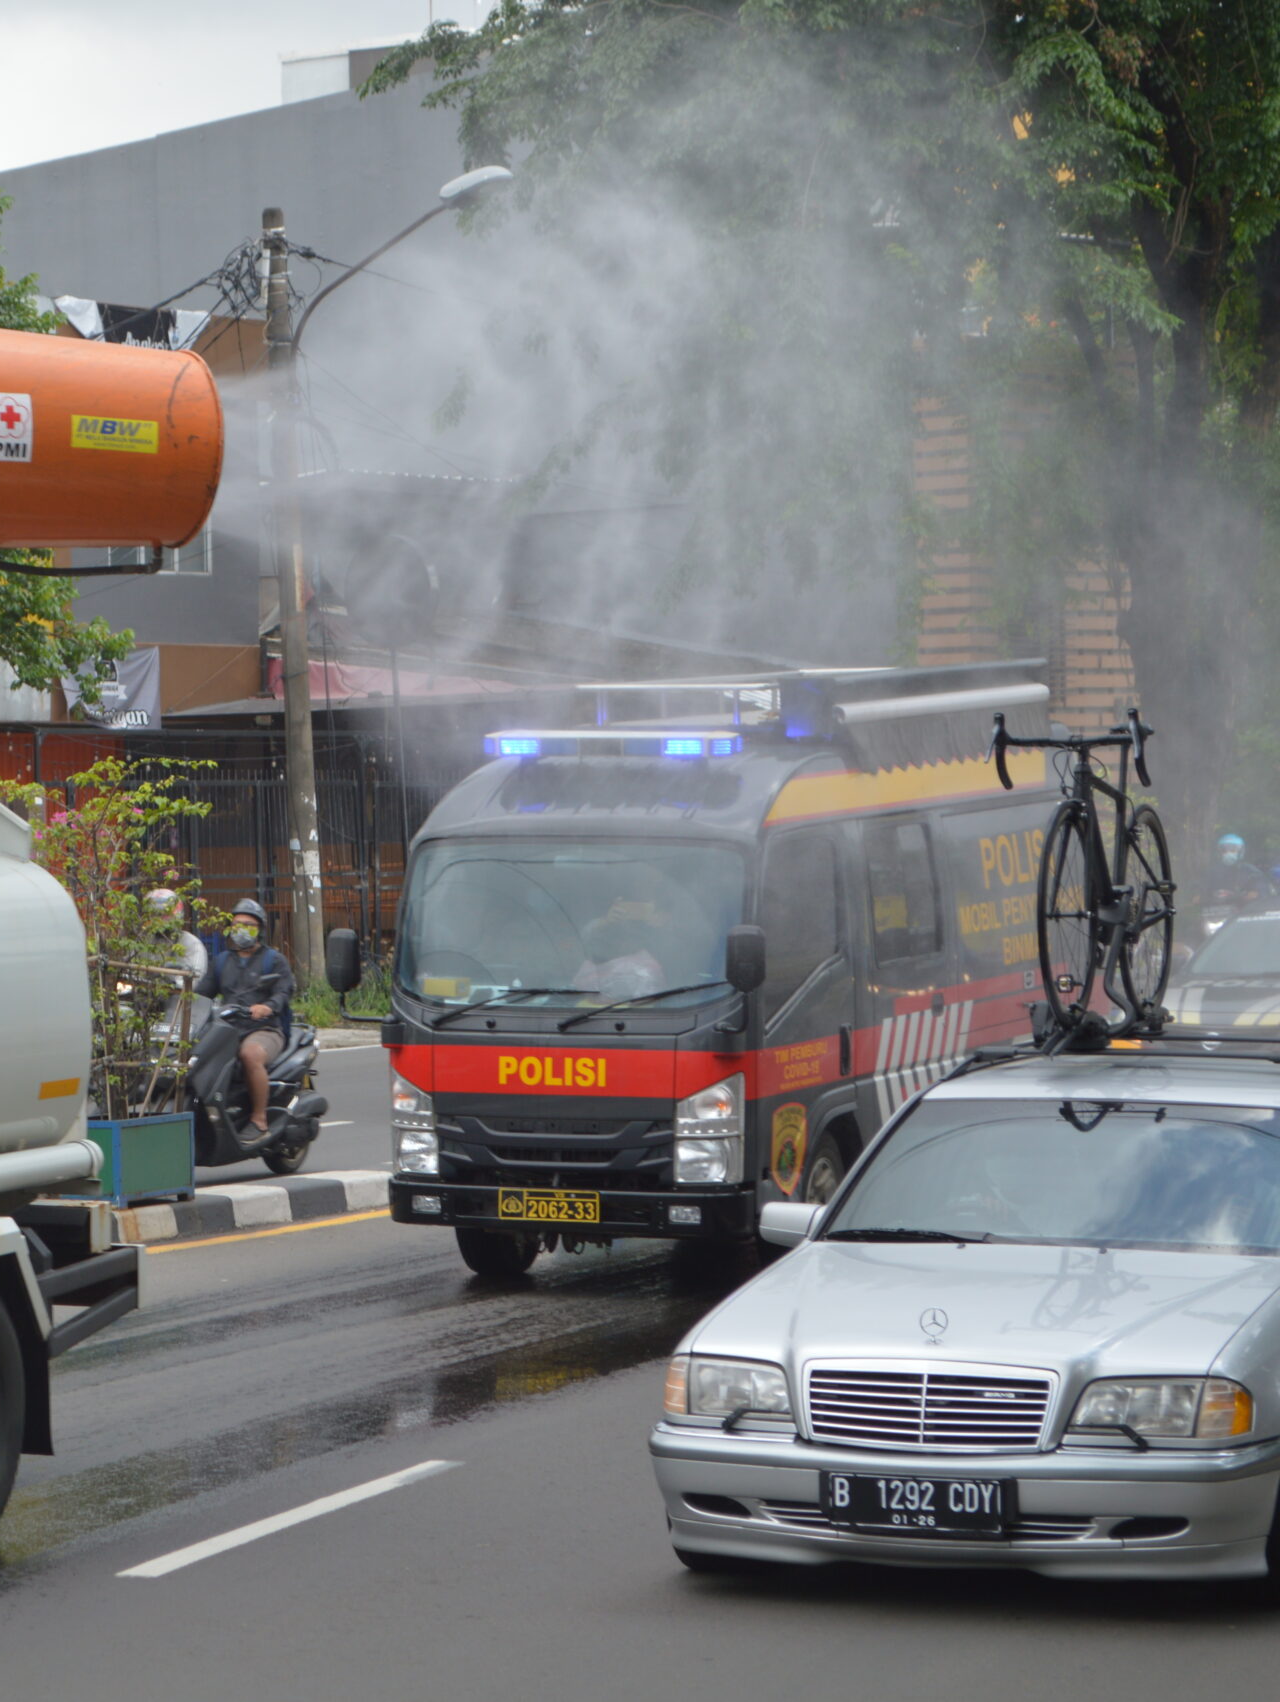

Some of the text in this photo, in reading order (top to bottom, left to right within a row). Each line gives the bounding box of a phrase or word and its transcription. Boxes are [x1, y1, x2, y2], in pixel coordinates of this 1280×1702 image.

[76, 417, 141, 437] MBW
[959, 902, 1001, 935] MOBIL
[498, 1055, 607, 1087] POLISI
[527, 1200, 595, 1220] 2062-33
[833, 1477, 994, 1514] B 1292 CDY
